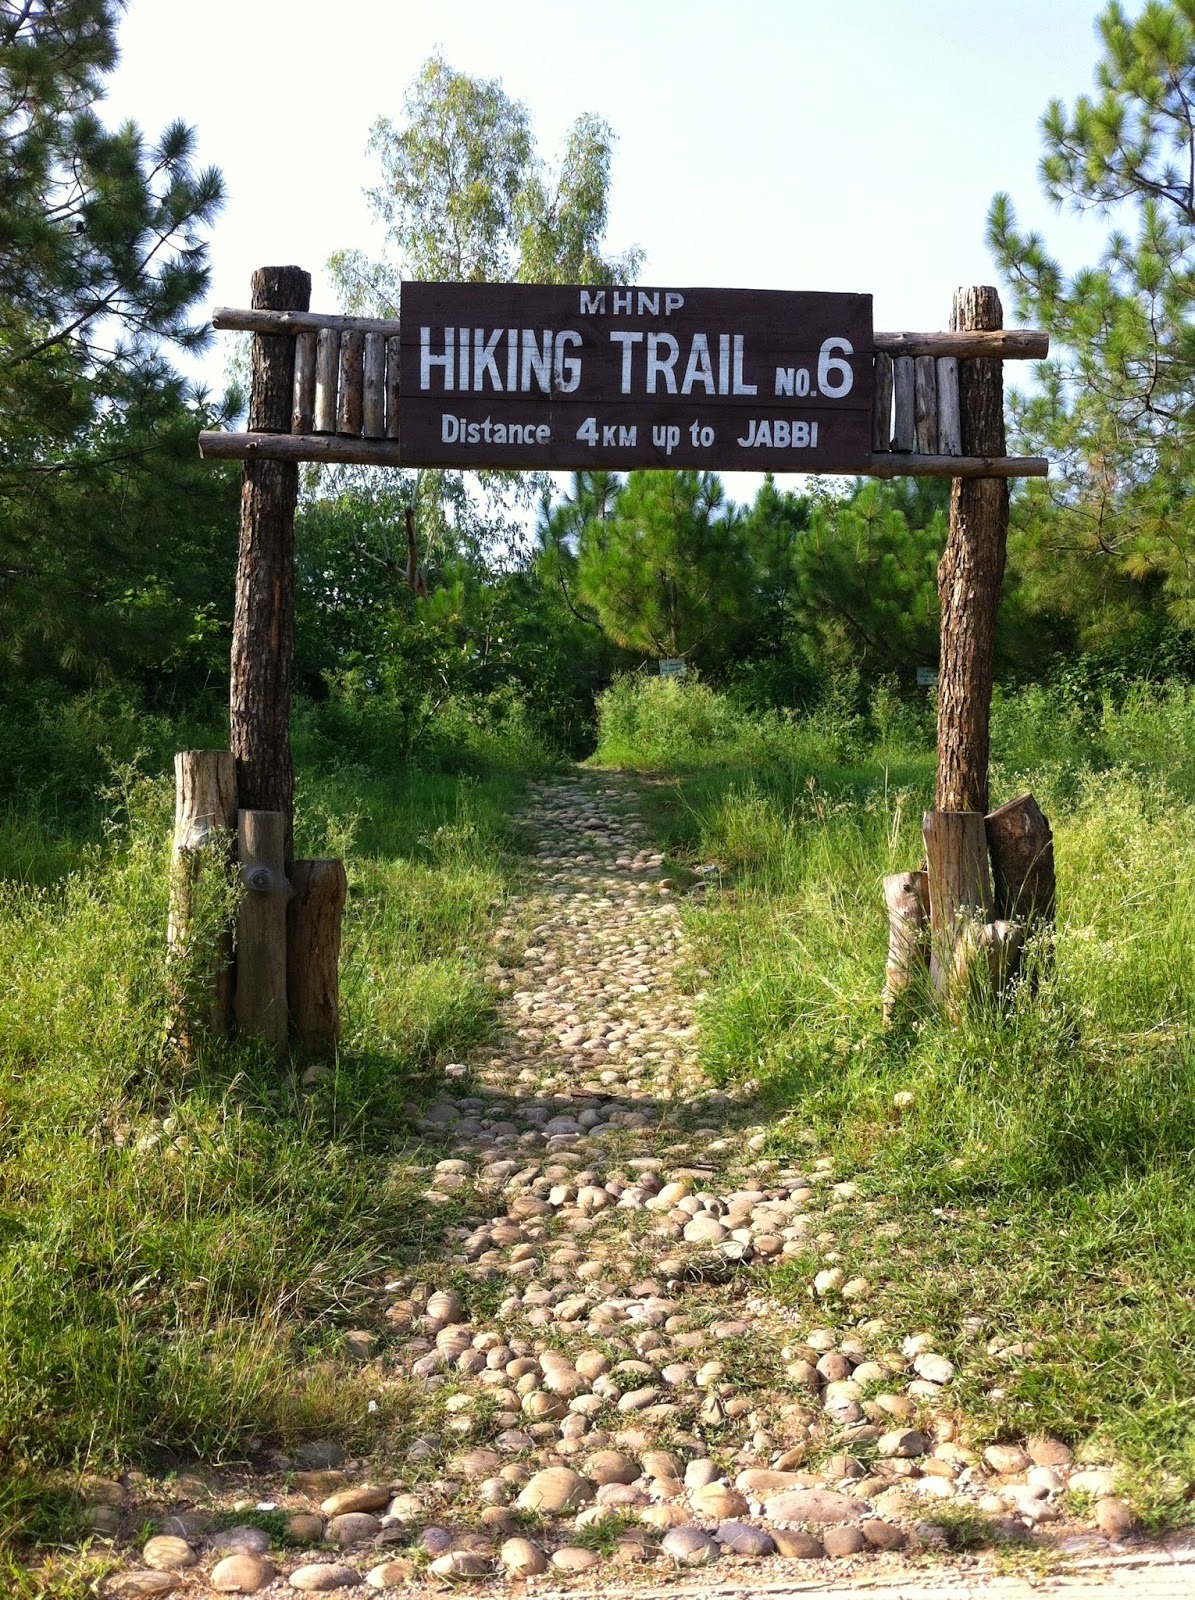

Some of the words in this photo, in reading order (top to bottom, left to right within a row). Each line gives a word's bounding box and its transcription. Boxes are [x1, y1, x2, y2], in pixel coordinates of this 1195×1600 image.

[579, 290, 685, 317] MHNP
[419, 326, 583, 395] HIKING
[609, 330, 758, 397] TRAIL
[441, 413, 552, 446] Distance
[652, 424, 681, 455] up
[689, 418, 716, 448] to
[737, 420, 819, 449] JABBI
